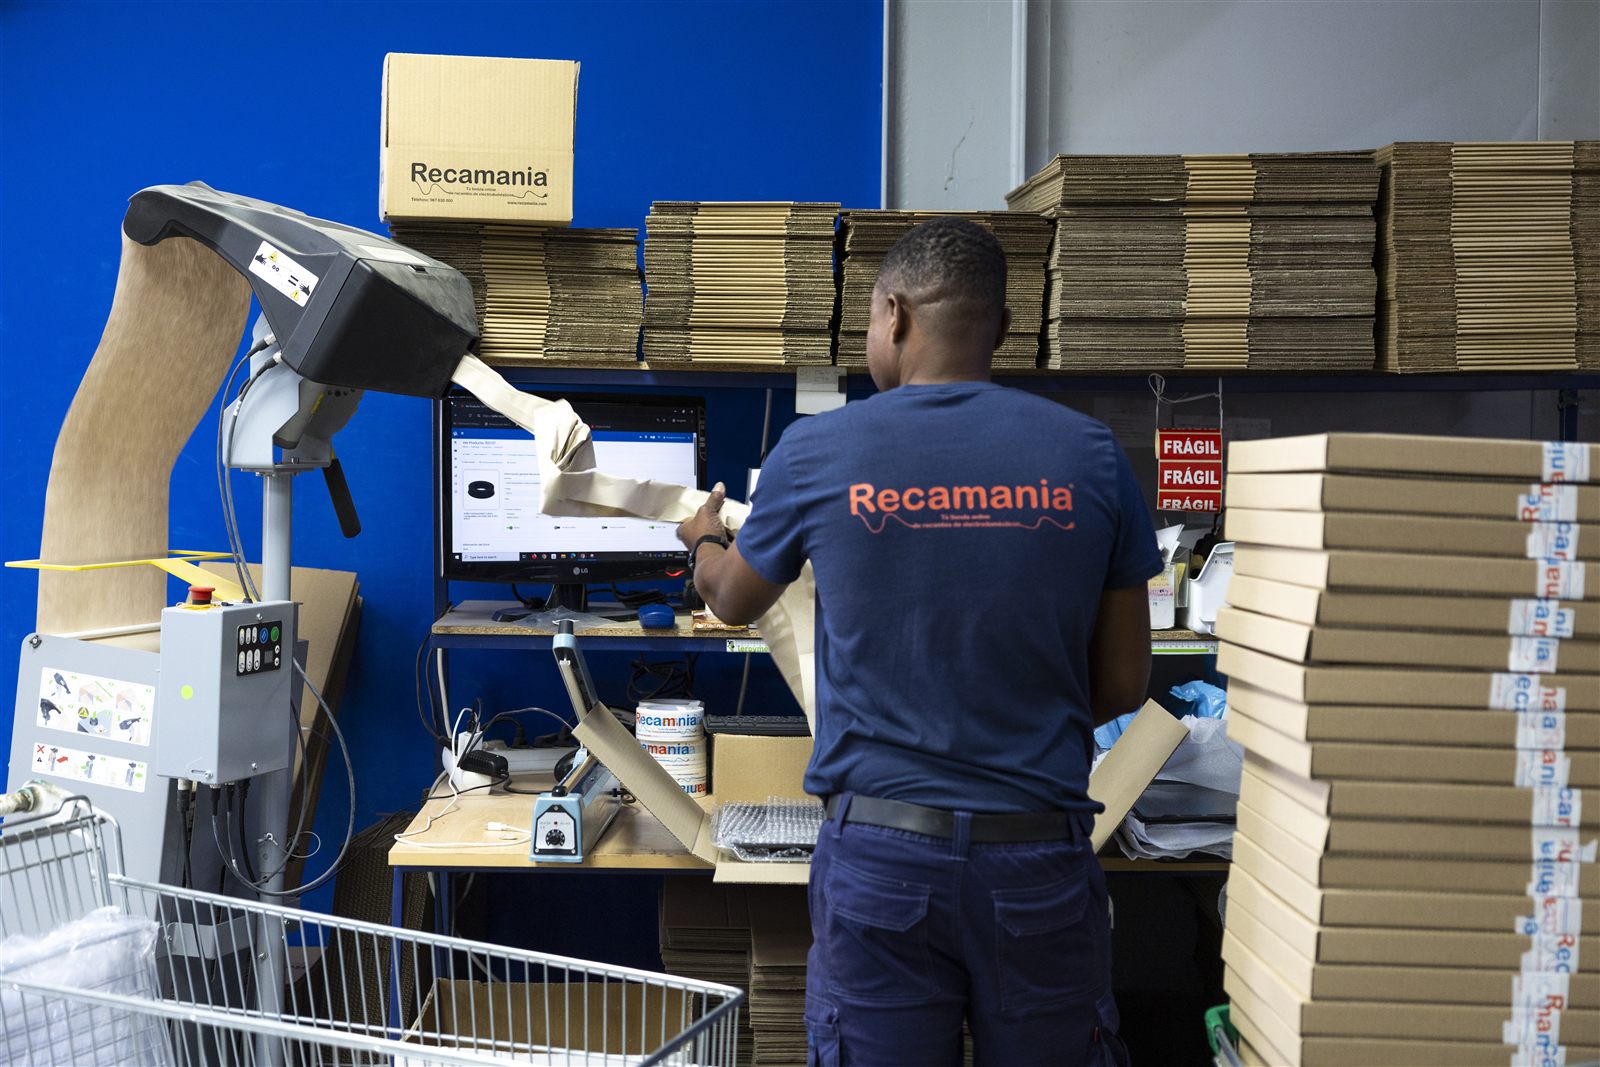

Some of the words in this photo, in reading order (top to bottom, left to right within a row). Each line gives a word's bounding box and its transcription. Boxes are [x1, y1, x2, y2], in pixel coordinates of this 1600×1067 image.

[411, 162, 548, 187] Recamania
[1163, 437, 1219, 455] FRÁGIL
[1163, 466, 1219, 485] FRÁGIL
[849, 479, 1073, 516] Recamania
[1162, 496, 1218, 511] FRÁGIL
[636, 712, 697, 728] Recamnia
